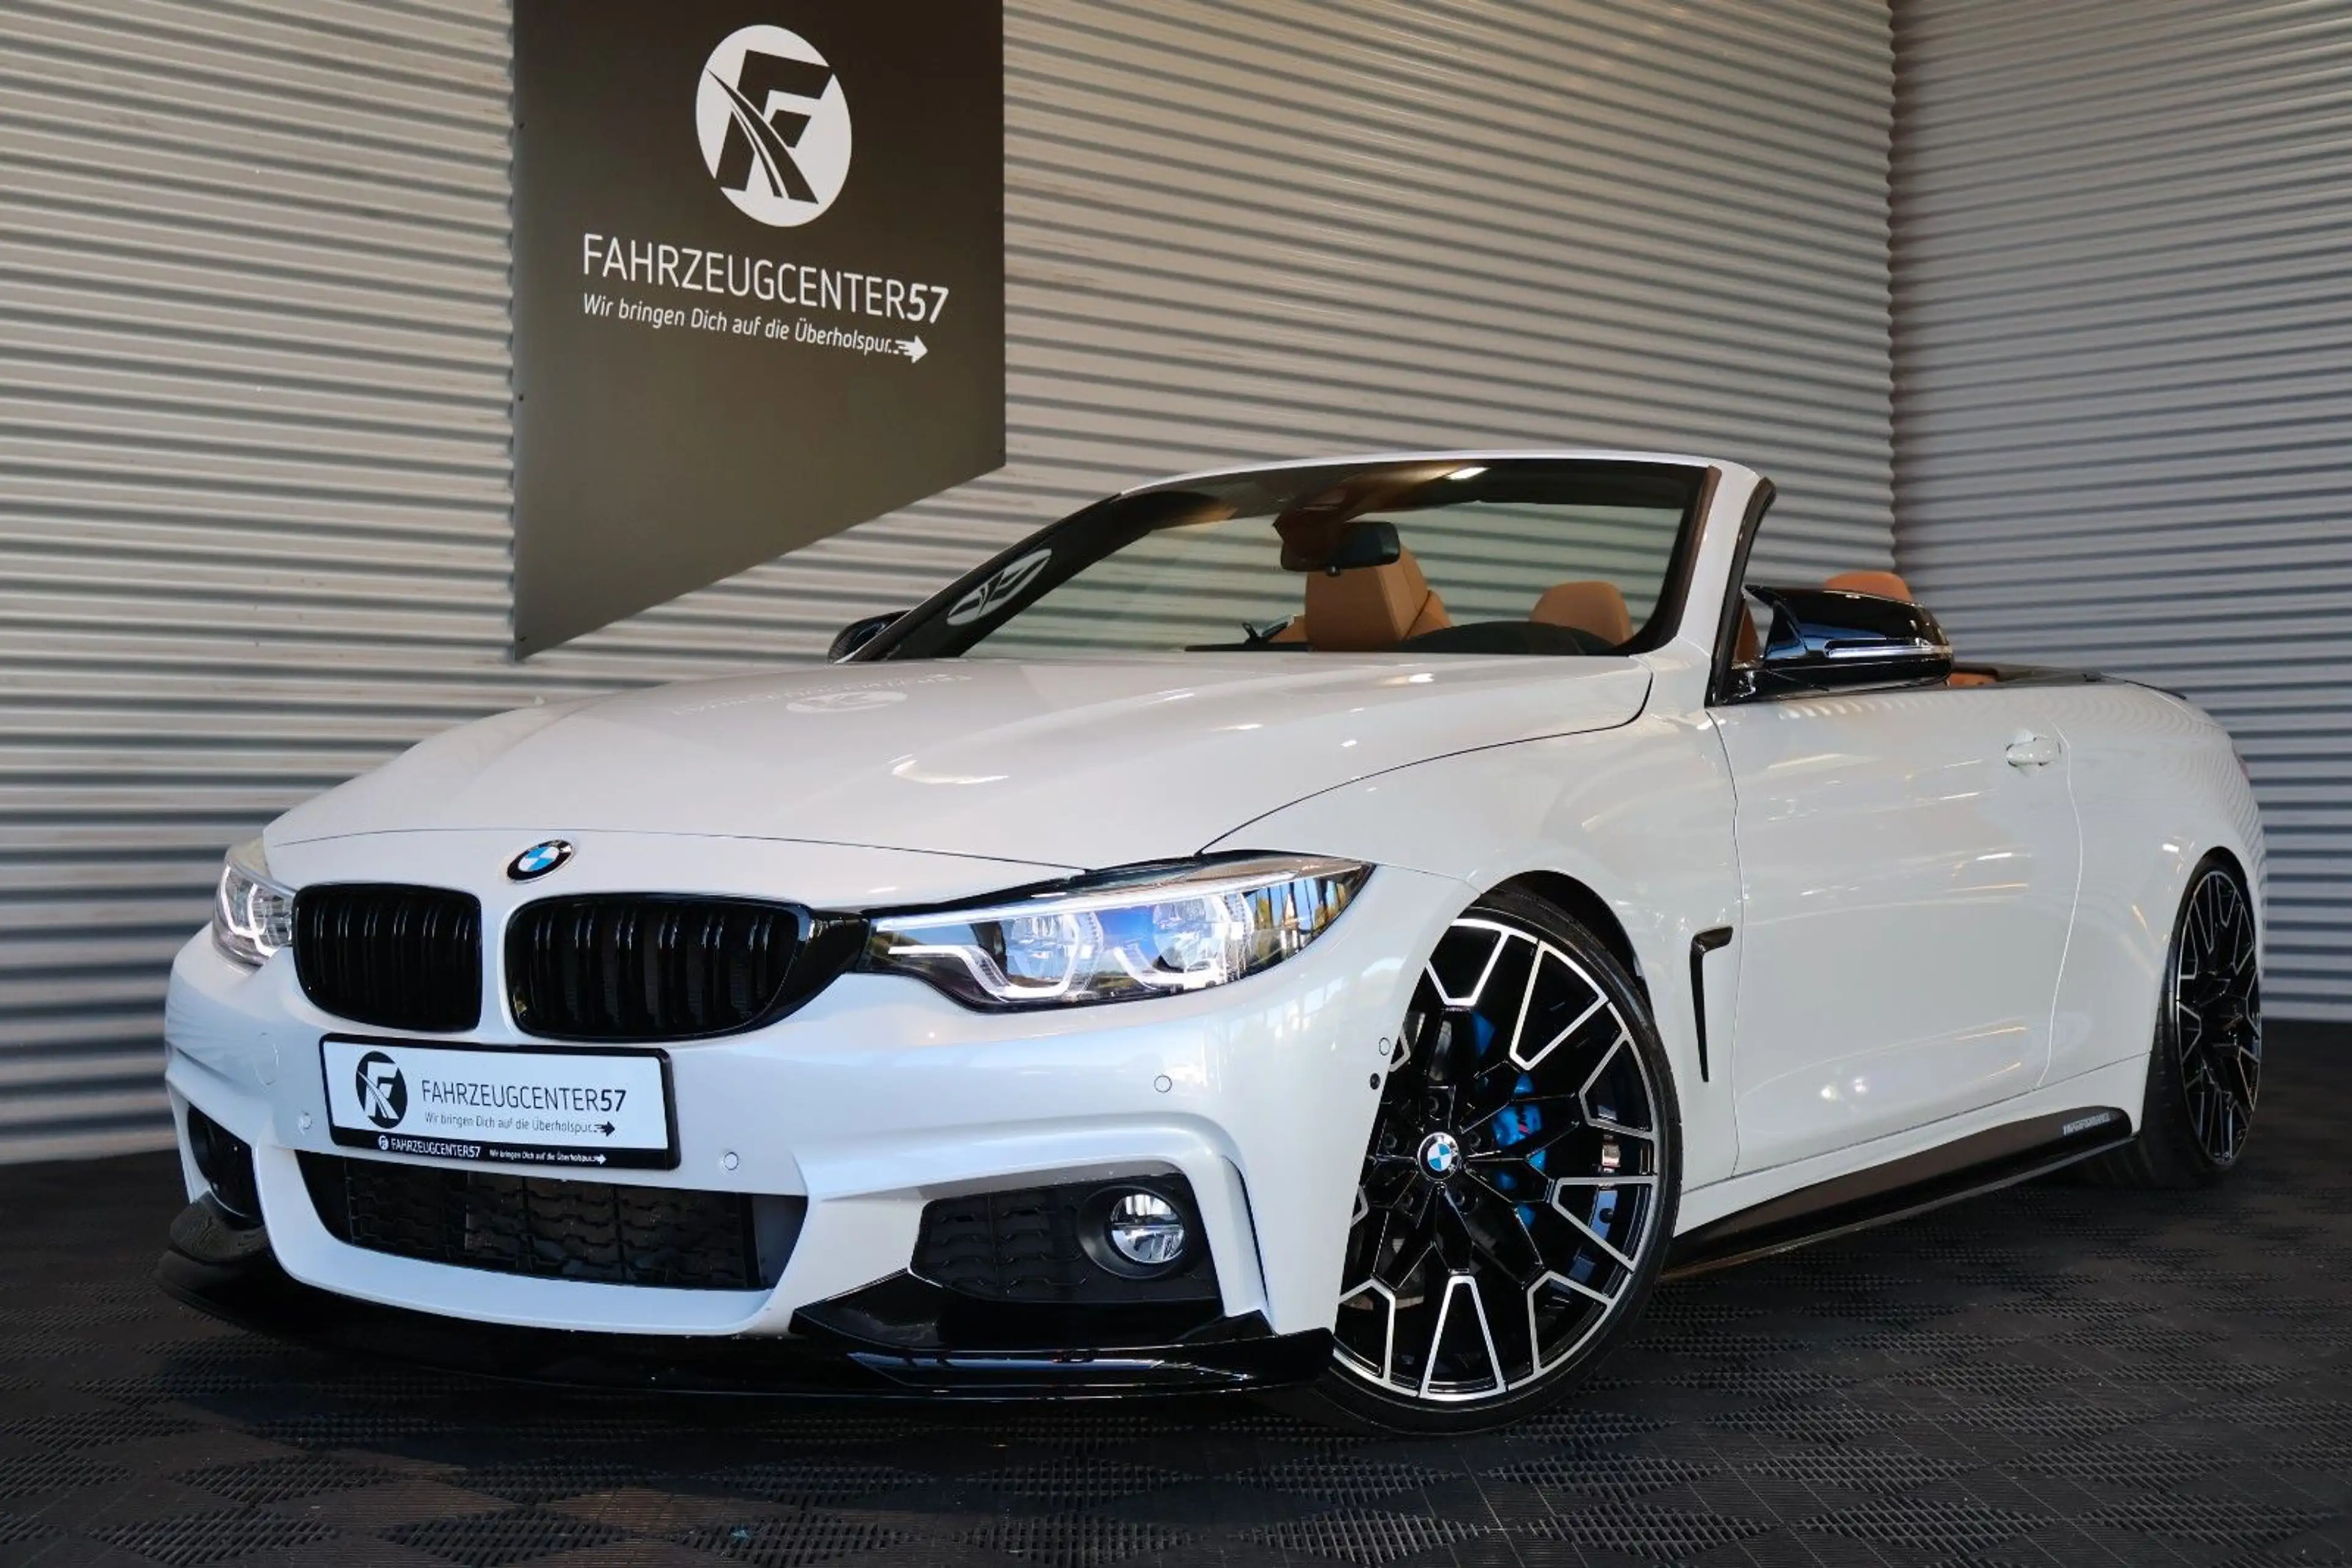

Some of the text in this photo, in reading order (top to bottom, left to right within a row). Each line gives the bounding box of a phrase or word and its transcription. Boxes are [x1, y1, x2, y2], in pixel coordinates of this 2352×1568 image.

[584, 233, 949, 323] FAHRZEUGCENTER57
[584, 293, 614, 317] Wir
[618, 298, 685, 328] bringen
[691, 307, 726, 331] Dich
[732, 317, 761, 336] auf
[765, 319, 790, 340] die
[421, 1080, 627, 1112] FAHRZEUGCENTER57
[424, 1112, 439, 1123] Wir
[440, 1113, 473, 1128] bringen
[476, 1115, 495, 1128] Dich
[497, 1117, 513, 1129] auf
[515, 1117, 530, 1129] die
[391, 1139, 481, 1158] FAHRZEUGCENTER57
